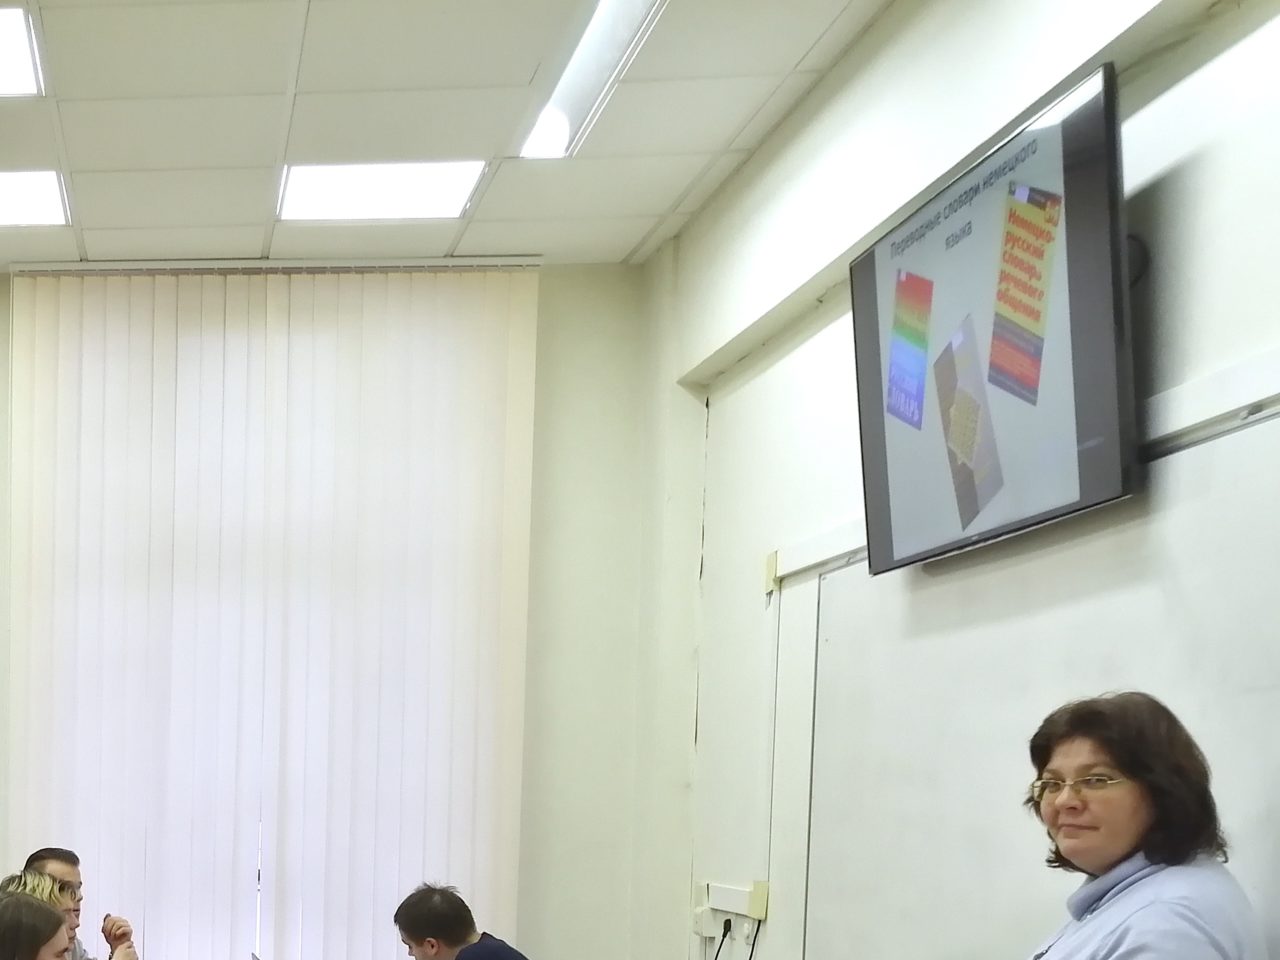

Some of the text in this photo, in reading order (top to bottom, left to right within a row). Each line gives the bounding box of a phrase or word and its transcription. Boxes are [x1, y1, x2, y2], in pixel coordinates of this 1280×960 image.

[890, 137, 1038, 259] Переводные словари немецкого
[945, 220, 973, 250] языка
[1004, 231, 1045, 261] русский
[1003, 251, 1042, 281] словарь
